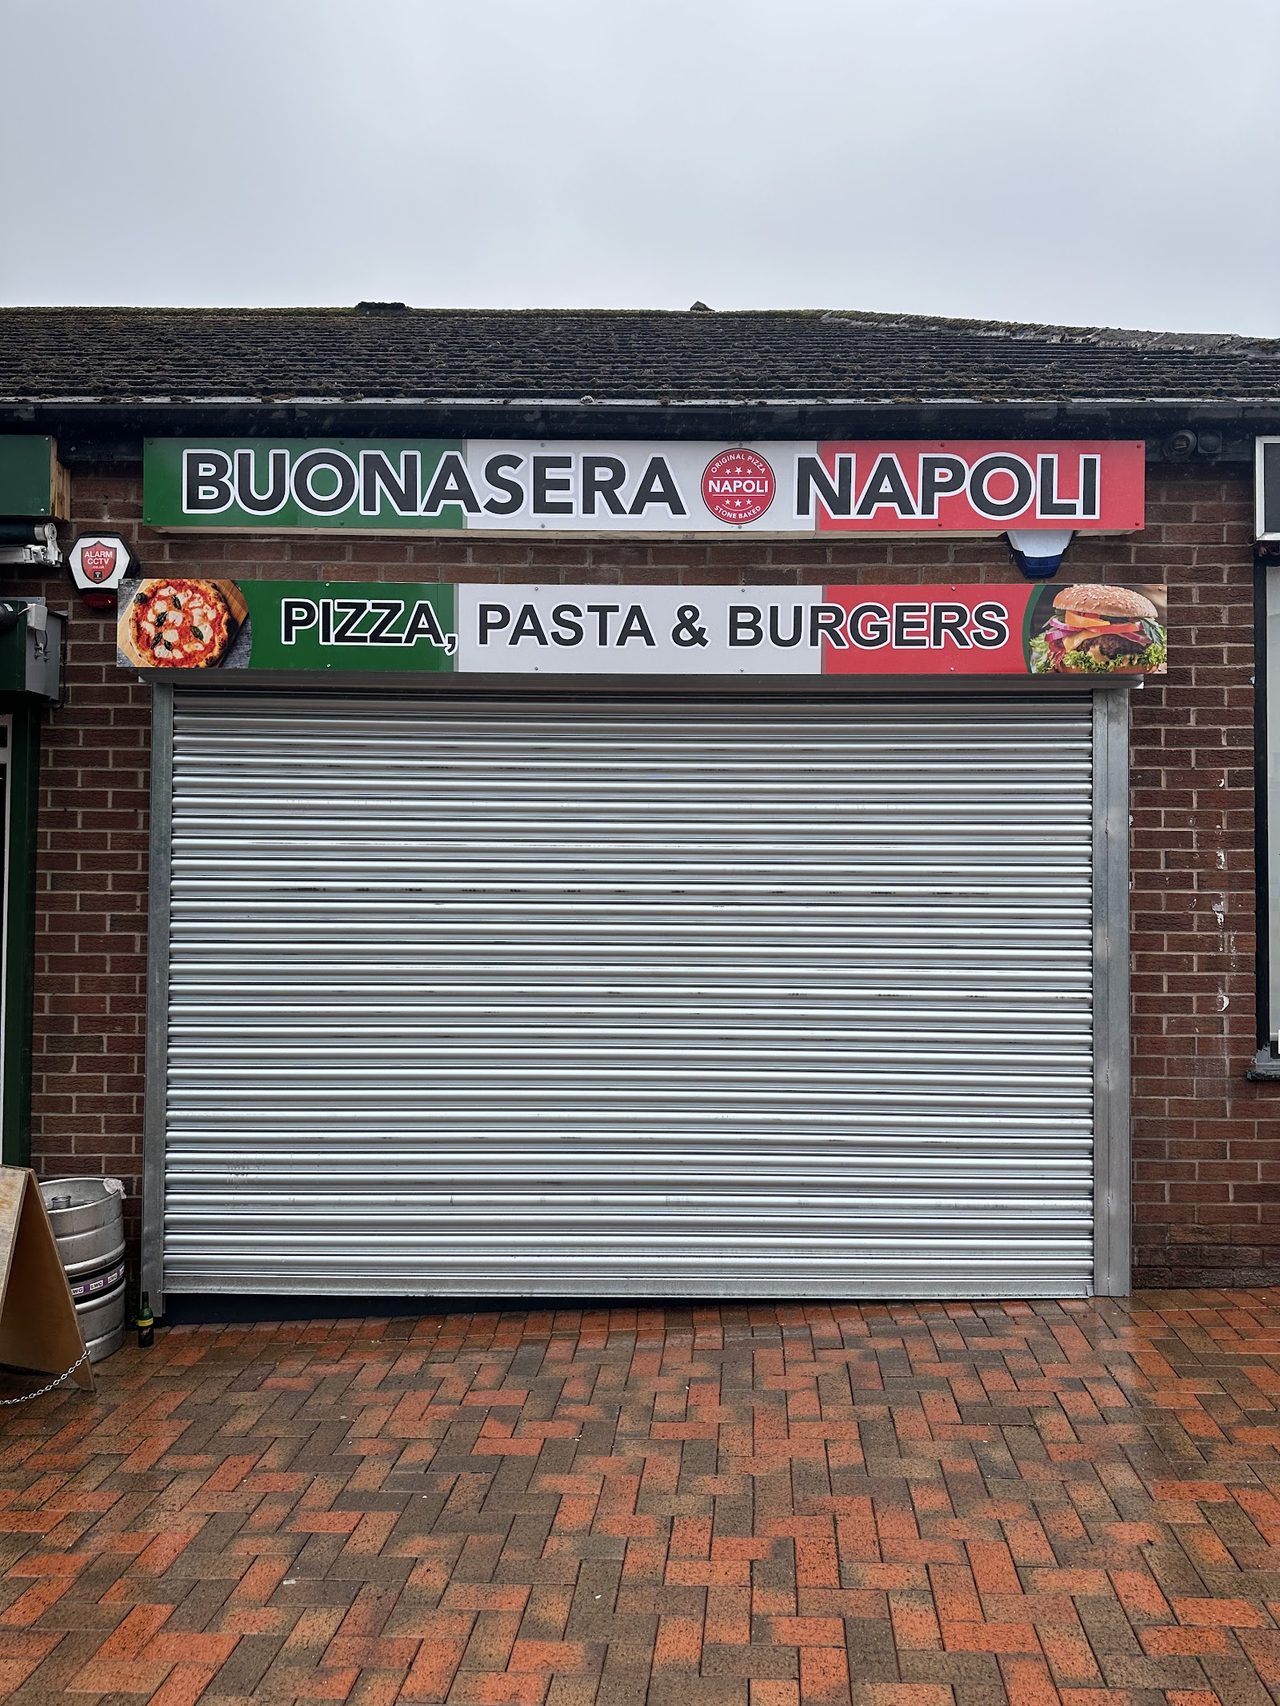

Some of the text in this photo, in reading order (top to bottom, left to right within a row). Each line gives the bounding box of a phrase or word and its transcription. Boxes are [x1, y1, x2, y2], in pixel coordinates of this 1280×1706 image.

[711, 453, 766, 474] ORIGINAL PIZZA
[183, 448, 1100, 520] BUONASERA NAPOLI
[708, 480, 769, 493] NAPOLI
[714, 505, 761, 519] STONE BAKED
[281, 598, 1008, 655] PIZZA, PASTA & BURGERS
